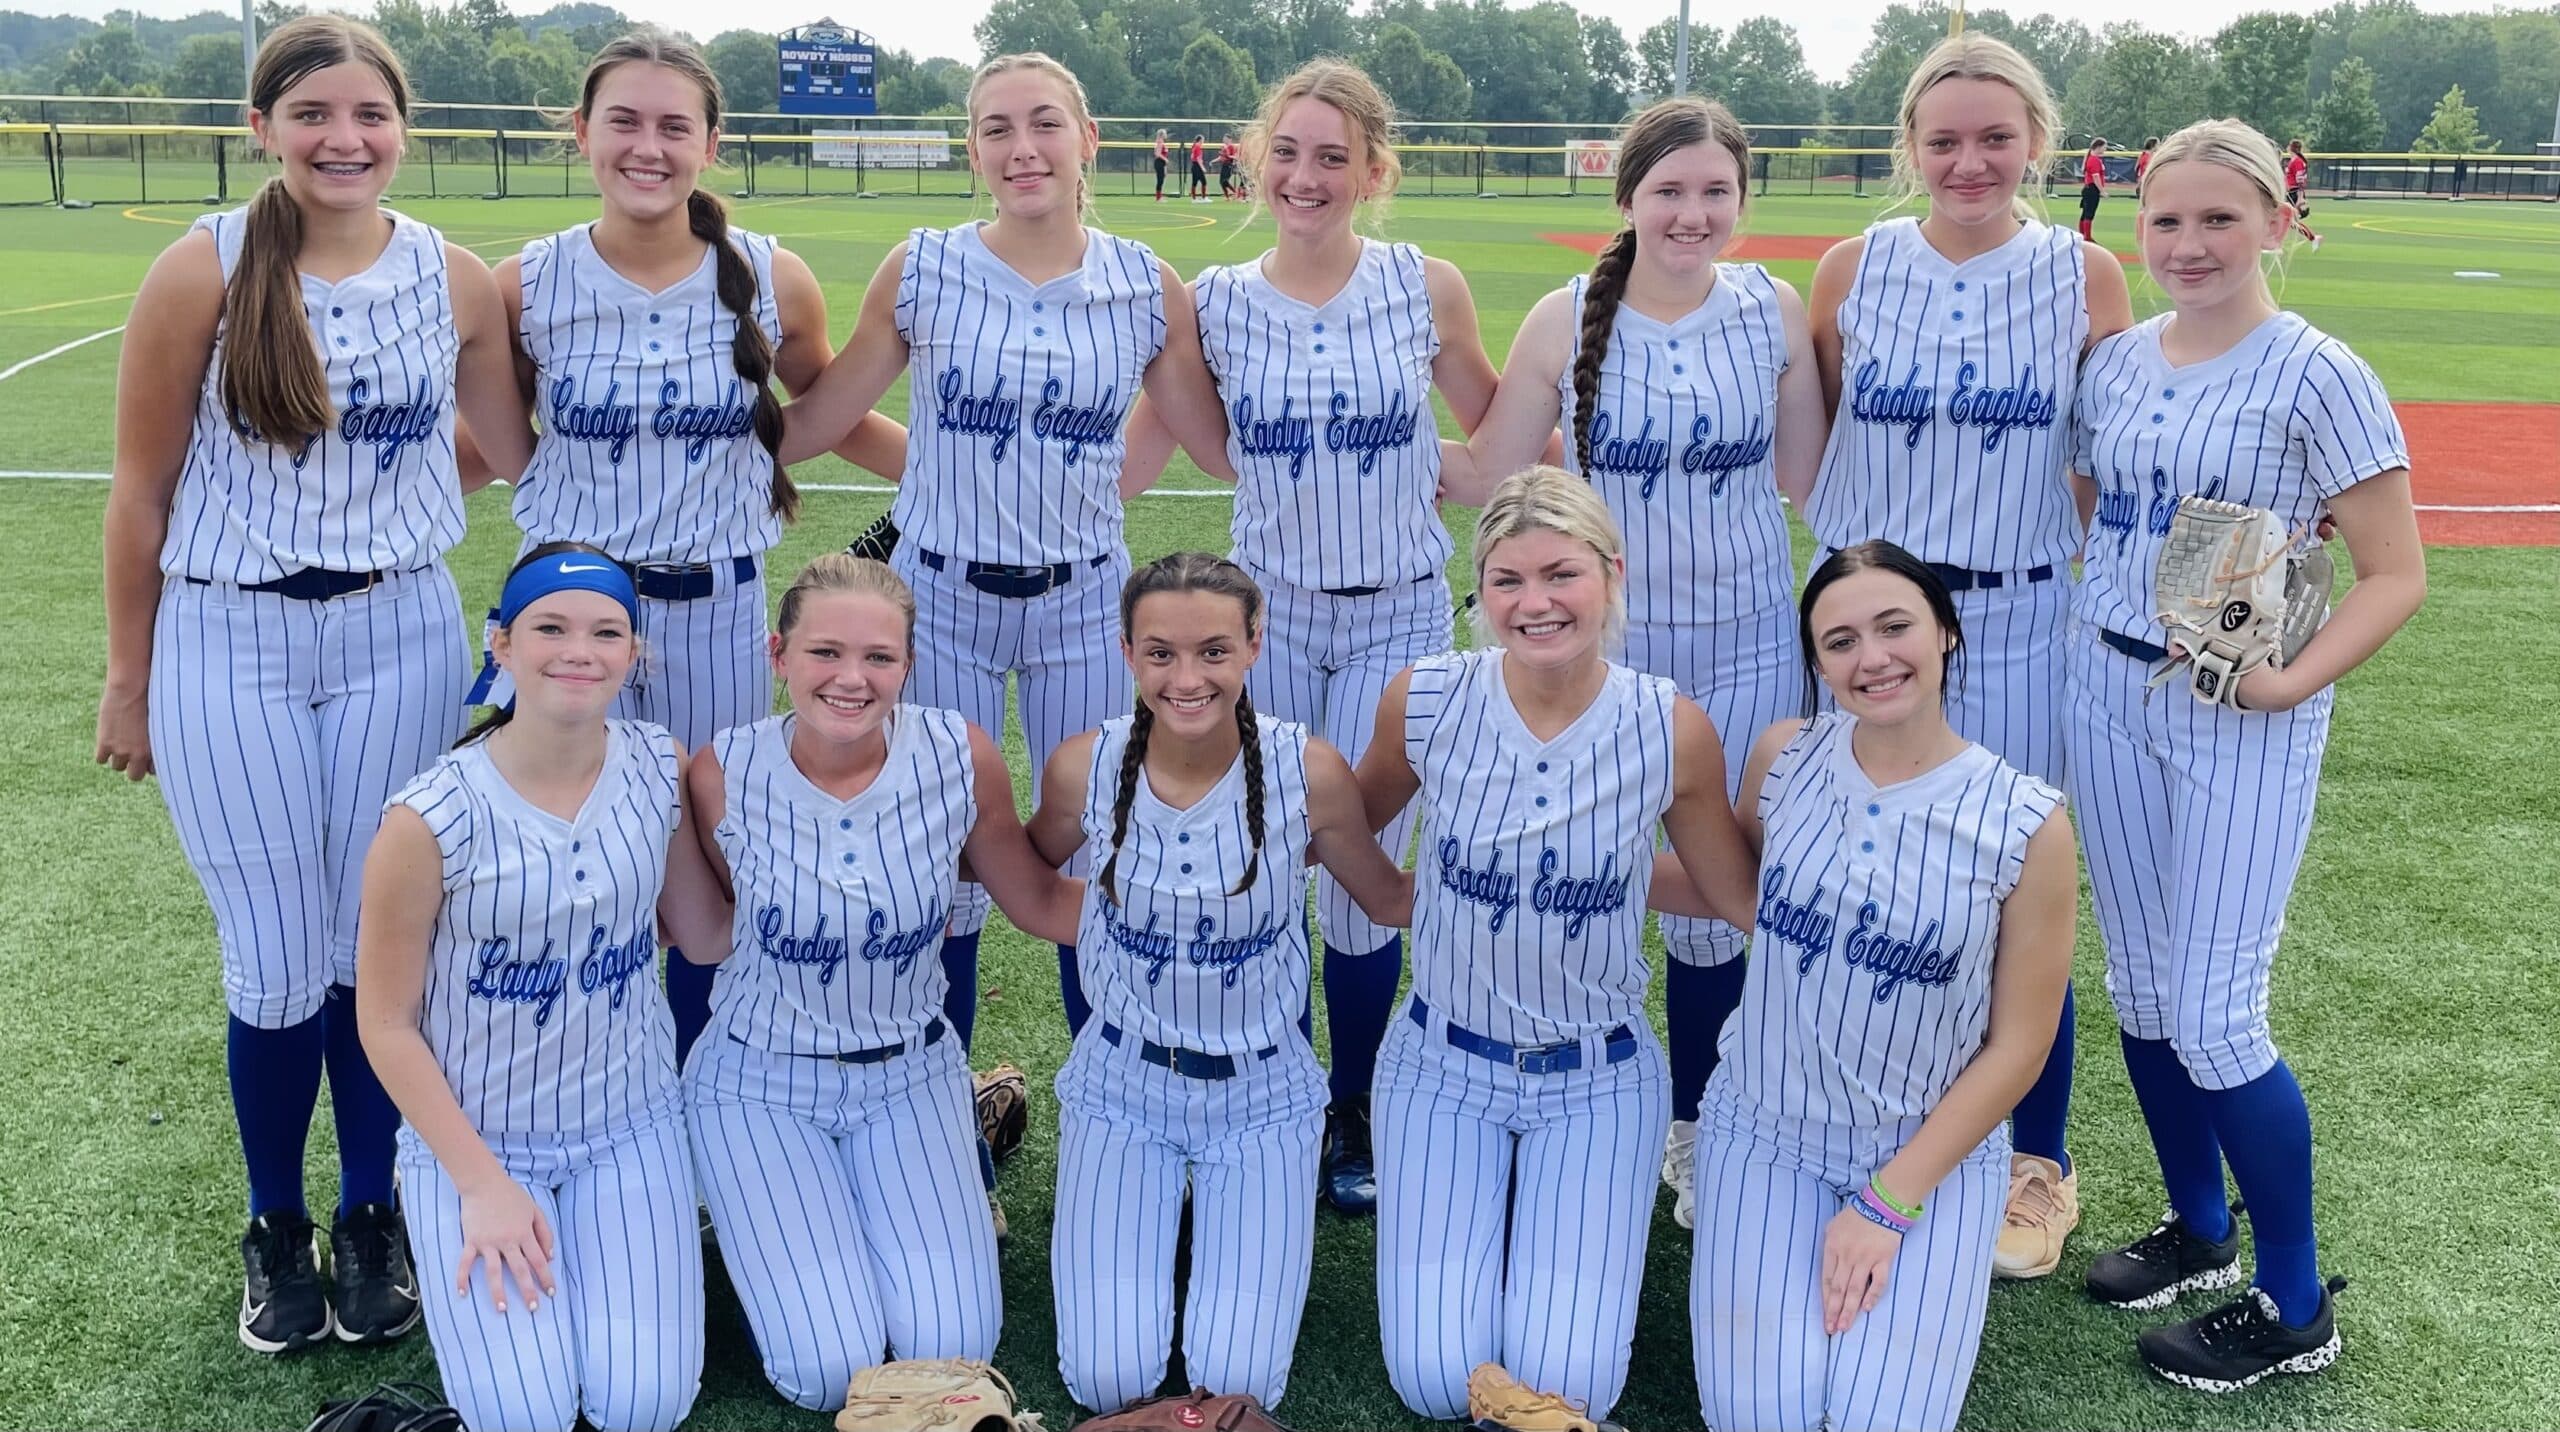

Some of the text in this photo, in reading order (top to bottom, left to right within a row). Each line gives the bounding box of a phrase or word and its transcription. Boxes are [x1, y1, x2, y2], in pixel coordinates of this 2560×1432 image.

[781, 50, 827, 61] ROWDY
[850, 65, 873, 74] GUEST
[551, 374, 638, 466] Lady
[937, 366, 1019, 464] Lady
[1232, 393, 1313, 481] Lady
[1852, 356, 2057, 454] Lady Eagles
[1588, 410, 1669, 502] Lady
[2091, 463, 2138, 560] ady
[1439, 835, 1519, 934] Lady
[758, 903, 847, 987] Lady
[1757, 863, 1963, 1004] Lady Eagles
[468, 935, 565, 1029] Lady
